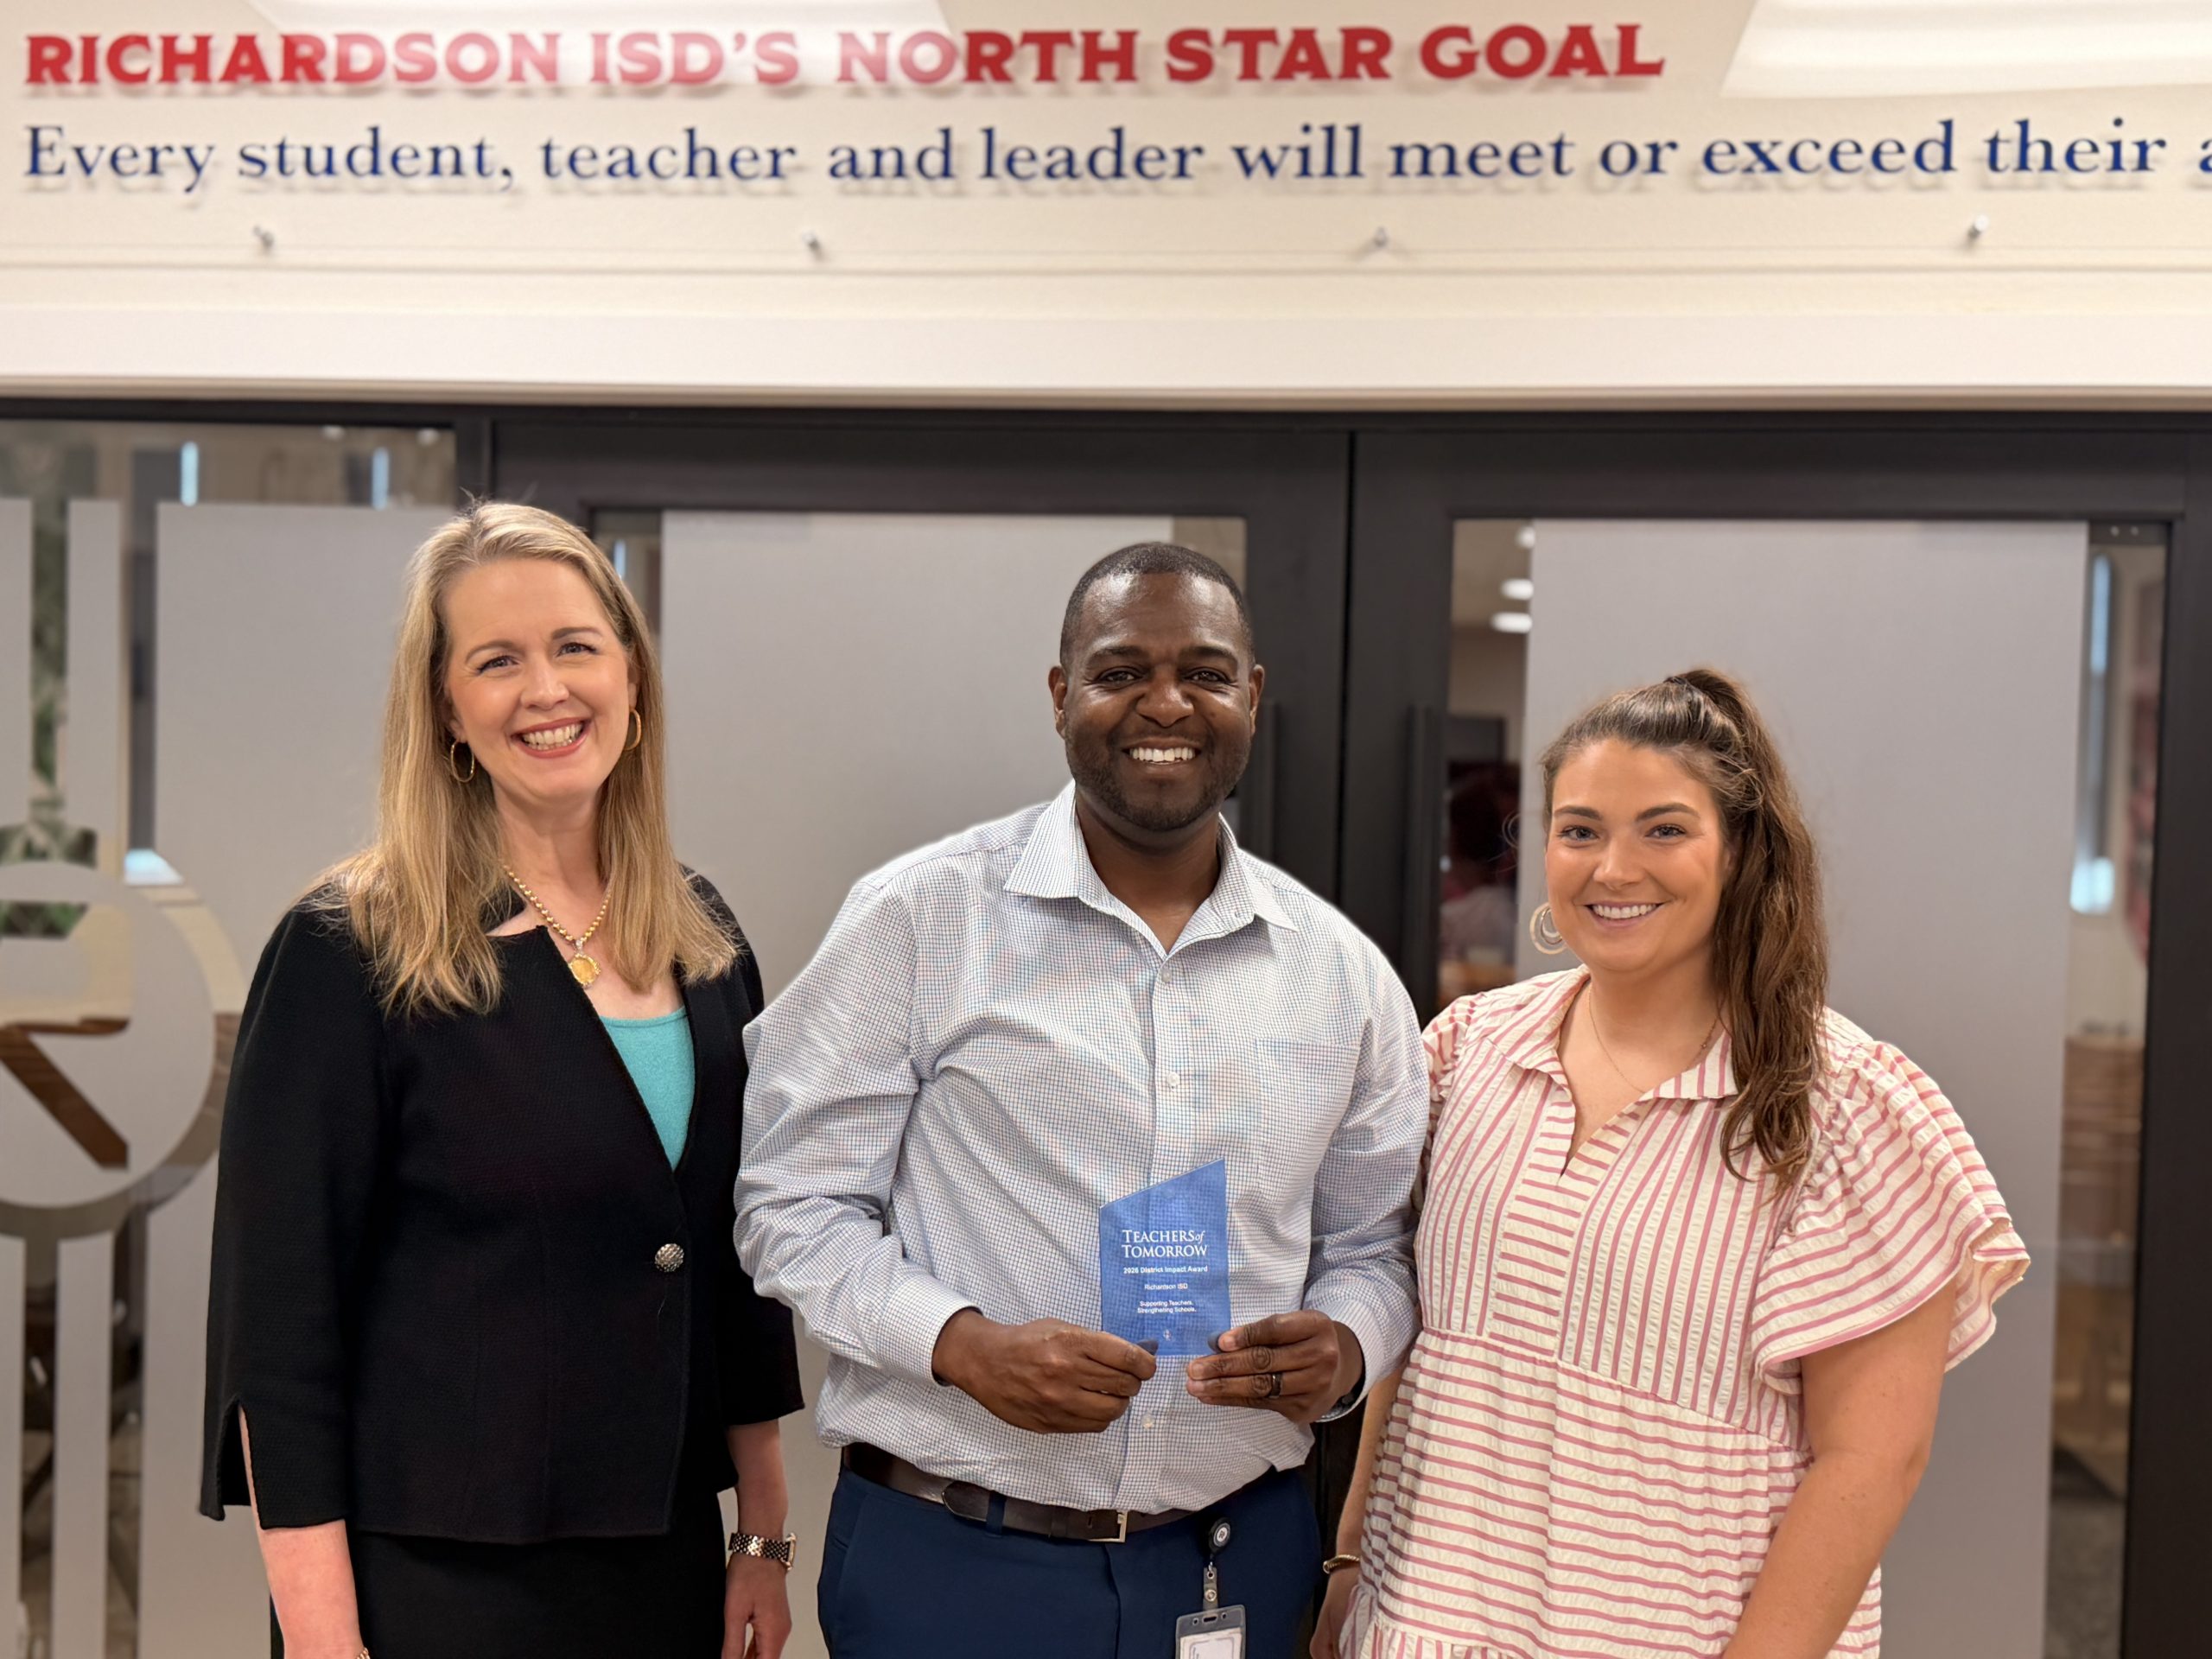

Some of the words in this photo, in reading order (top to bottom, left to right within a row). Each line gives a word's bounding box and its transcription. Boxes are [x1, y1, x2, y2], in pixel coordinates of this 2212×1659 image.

[24, 32, 560, 86] RICHARDSON
[590, 31, 800, 85] ISD'S
[836, 29, 1141, 84] NORTH
[1165, 27, 1394, 82] STAR
[1419, 23, 1667, 80] GOAL
[23, 125, 215, 192] Every
[238, 127, 516, 192] student,
[541, 128, 798, 180] teacher
[828, 127, 953, 180] and
[980, 127, 1206, 181] leader
[1230, 124, 1364, 179] will
[1388, 133, 1575, 178] meet
[1599, 138, 1679, 175] or
[1702, 119, 1956, 175] exceed
[1984, 119, 2167, 174] their
[1121, 1244, 1208, 1258] TOMORROW
[1195, 1230, 1206, 1244] of
